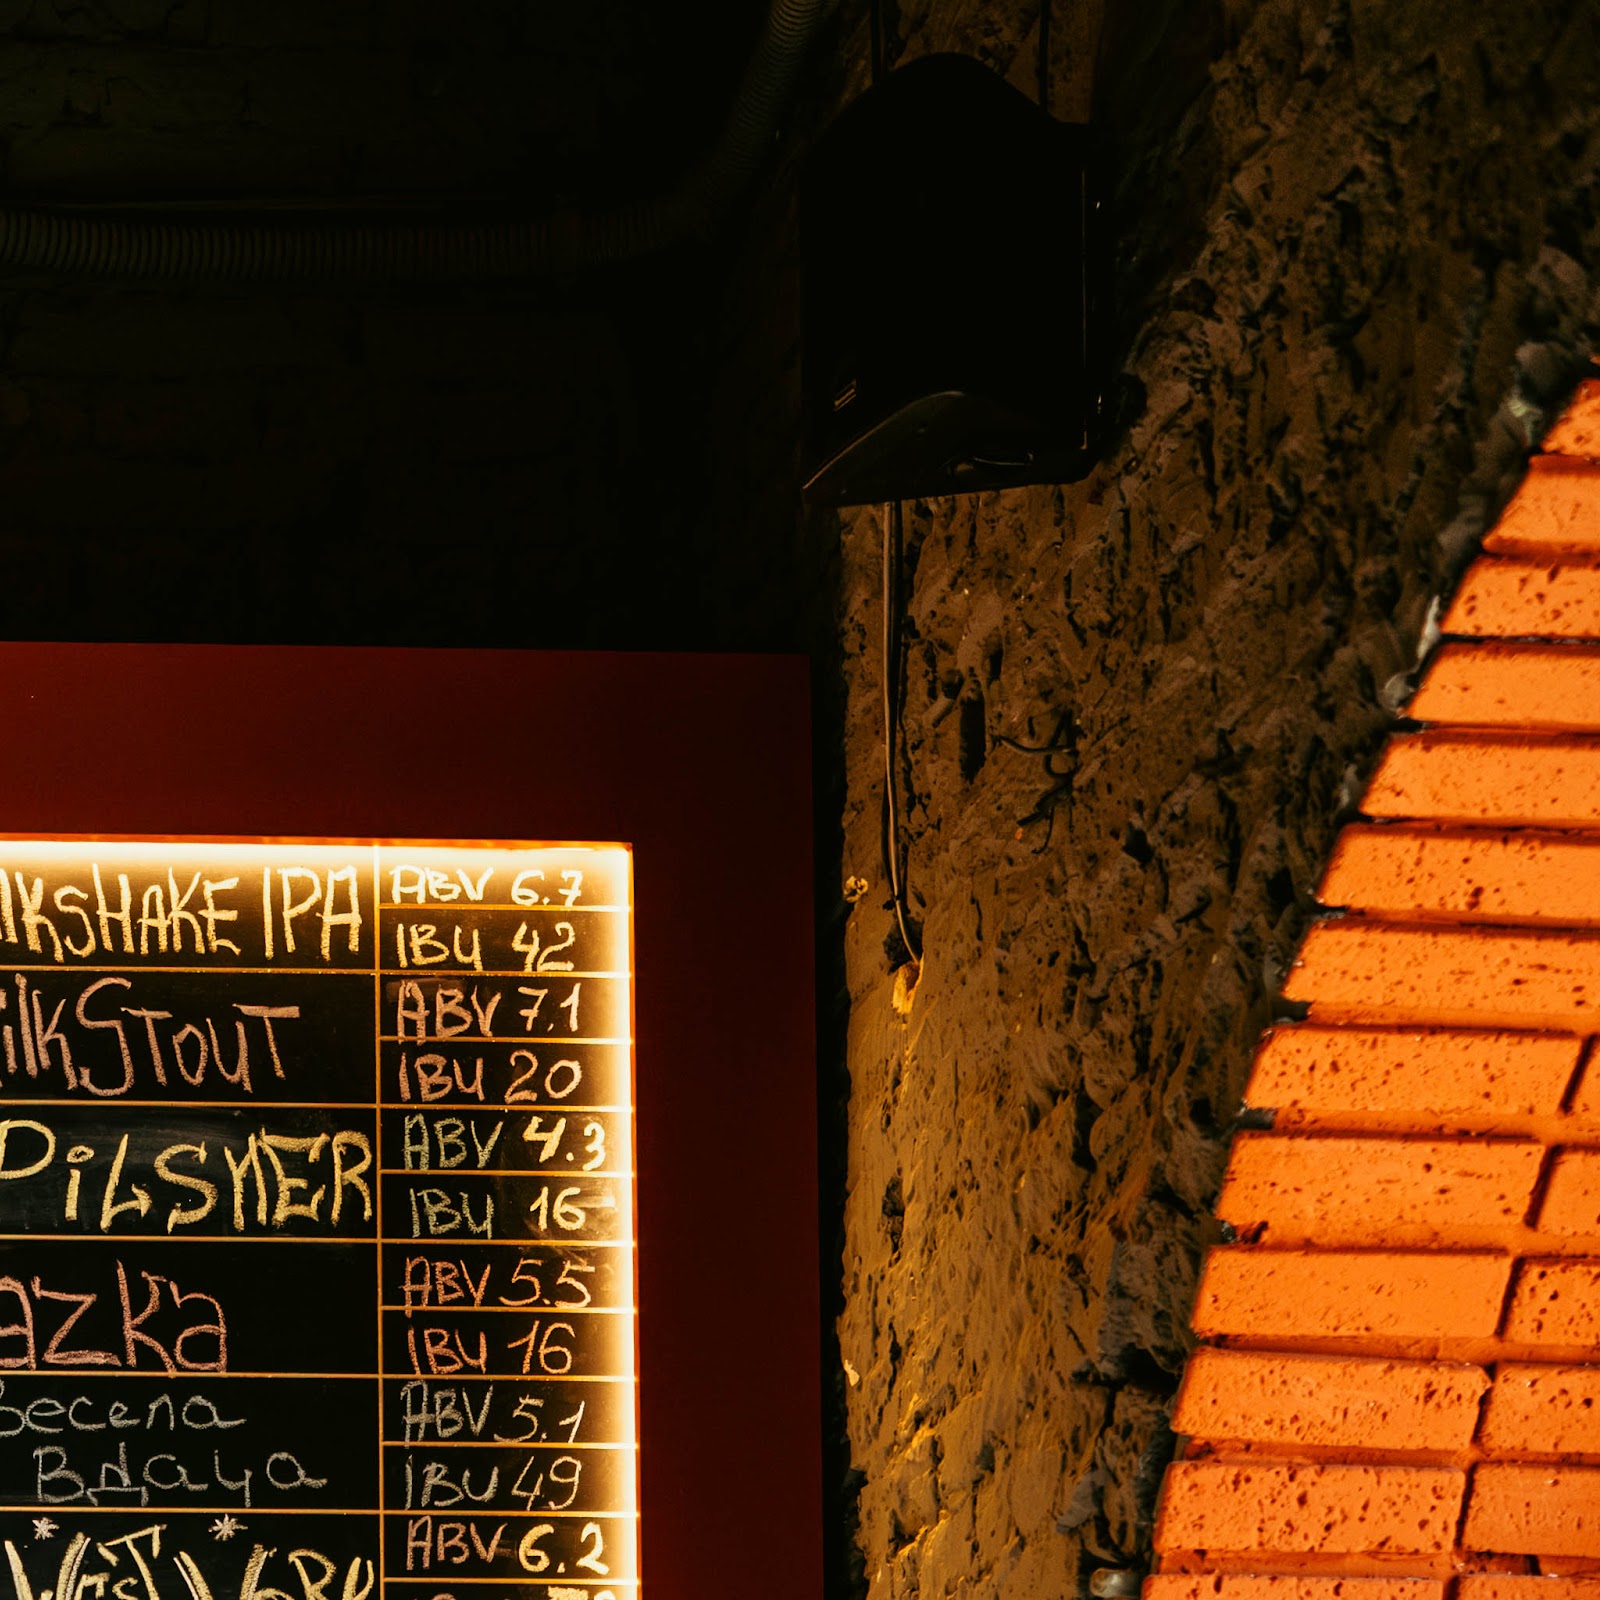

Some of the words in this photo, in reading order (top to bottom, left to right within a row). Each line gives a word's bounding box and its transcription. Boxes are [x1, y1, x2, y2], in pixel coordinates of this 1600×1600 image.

[264, 866, 361, 961] IPA
[389, 864, 493, 904] ABV
[510, 871, 583, 906] 6.7
[511, 922, 576, 972] 42
[397, 979, 501, 1044] ABV
[518, 982, 580, 1033] 7.1
[505, 1049, 582, 1104] 20
[403, 1112, 502, 1171] ABV
[523, 1115, 606, 1170] 4.3
[530, 1186, 587, 1231] 16
[399, 1255, 491, 1317] ABV
[499, 1258, 595, 1308] 5.5
[507, 1320, 576, 1374] 16
[400, 1379, 493, 1448] ABV
[494, 1394, 585, 1444] 5.1
[510, 1456, 582, 1510] 49
[406, 1515, 507, 1570] ABV
[518, 1522, 609, 1575] 6.2
